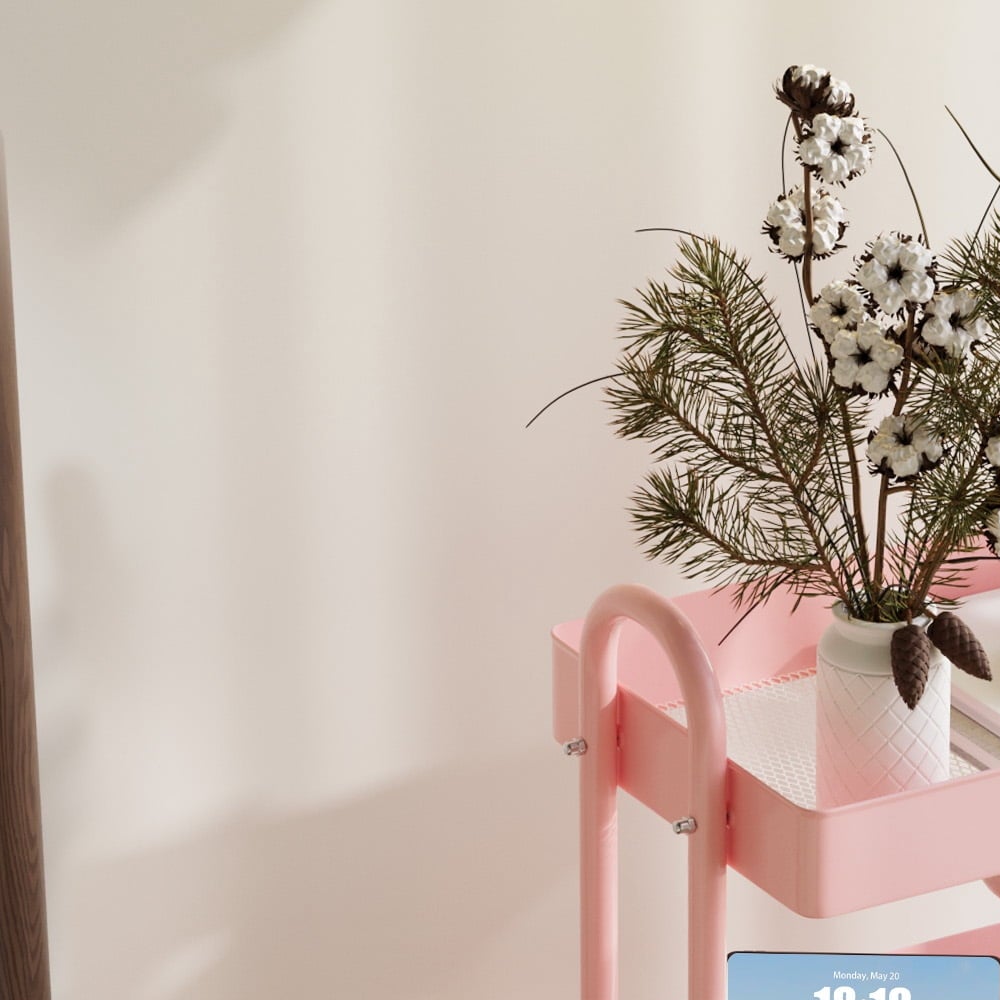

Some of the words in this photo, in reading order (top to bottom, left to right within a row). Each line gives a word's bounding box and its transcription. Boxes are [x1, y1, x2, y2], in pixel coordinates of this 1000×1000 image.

[833, 971, 869, 981] Monday,
[870, 971, 888, 981] May
[889, 972, 900, 981] 20
